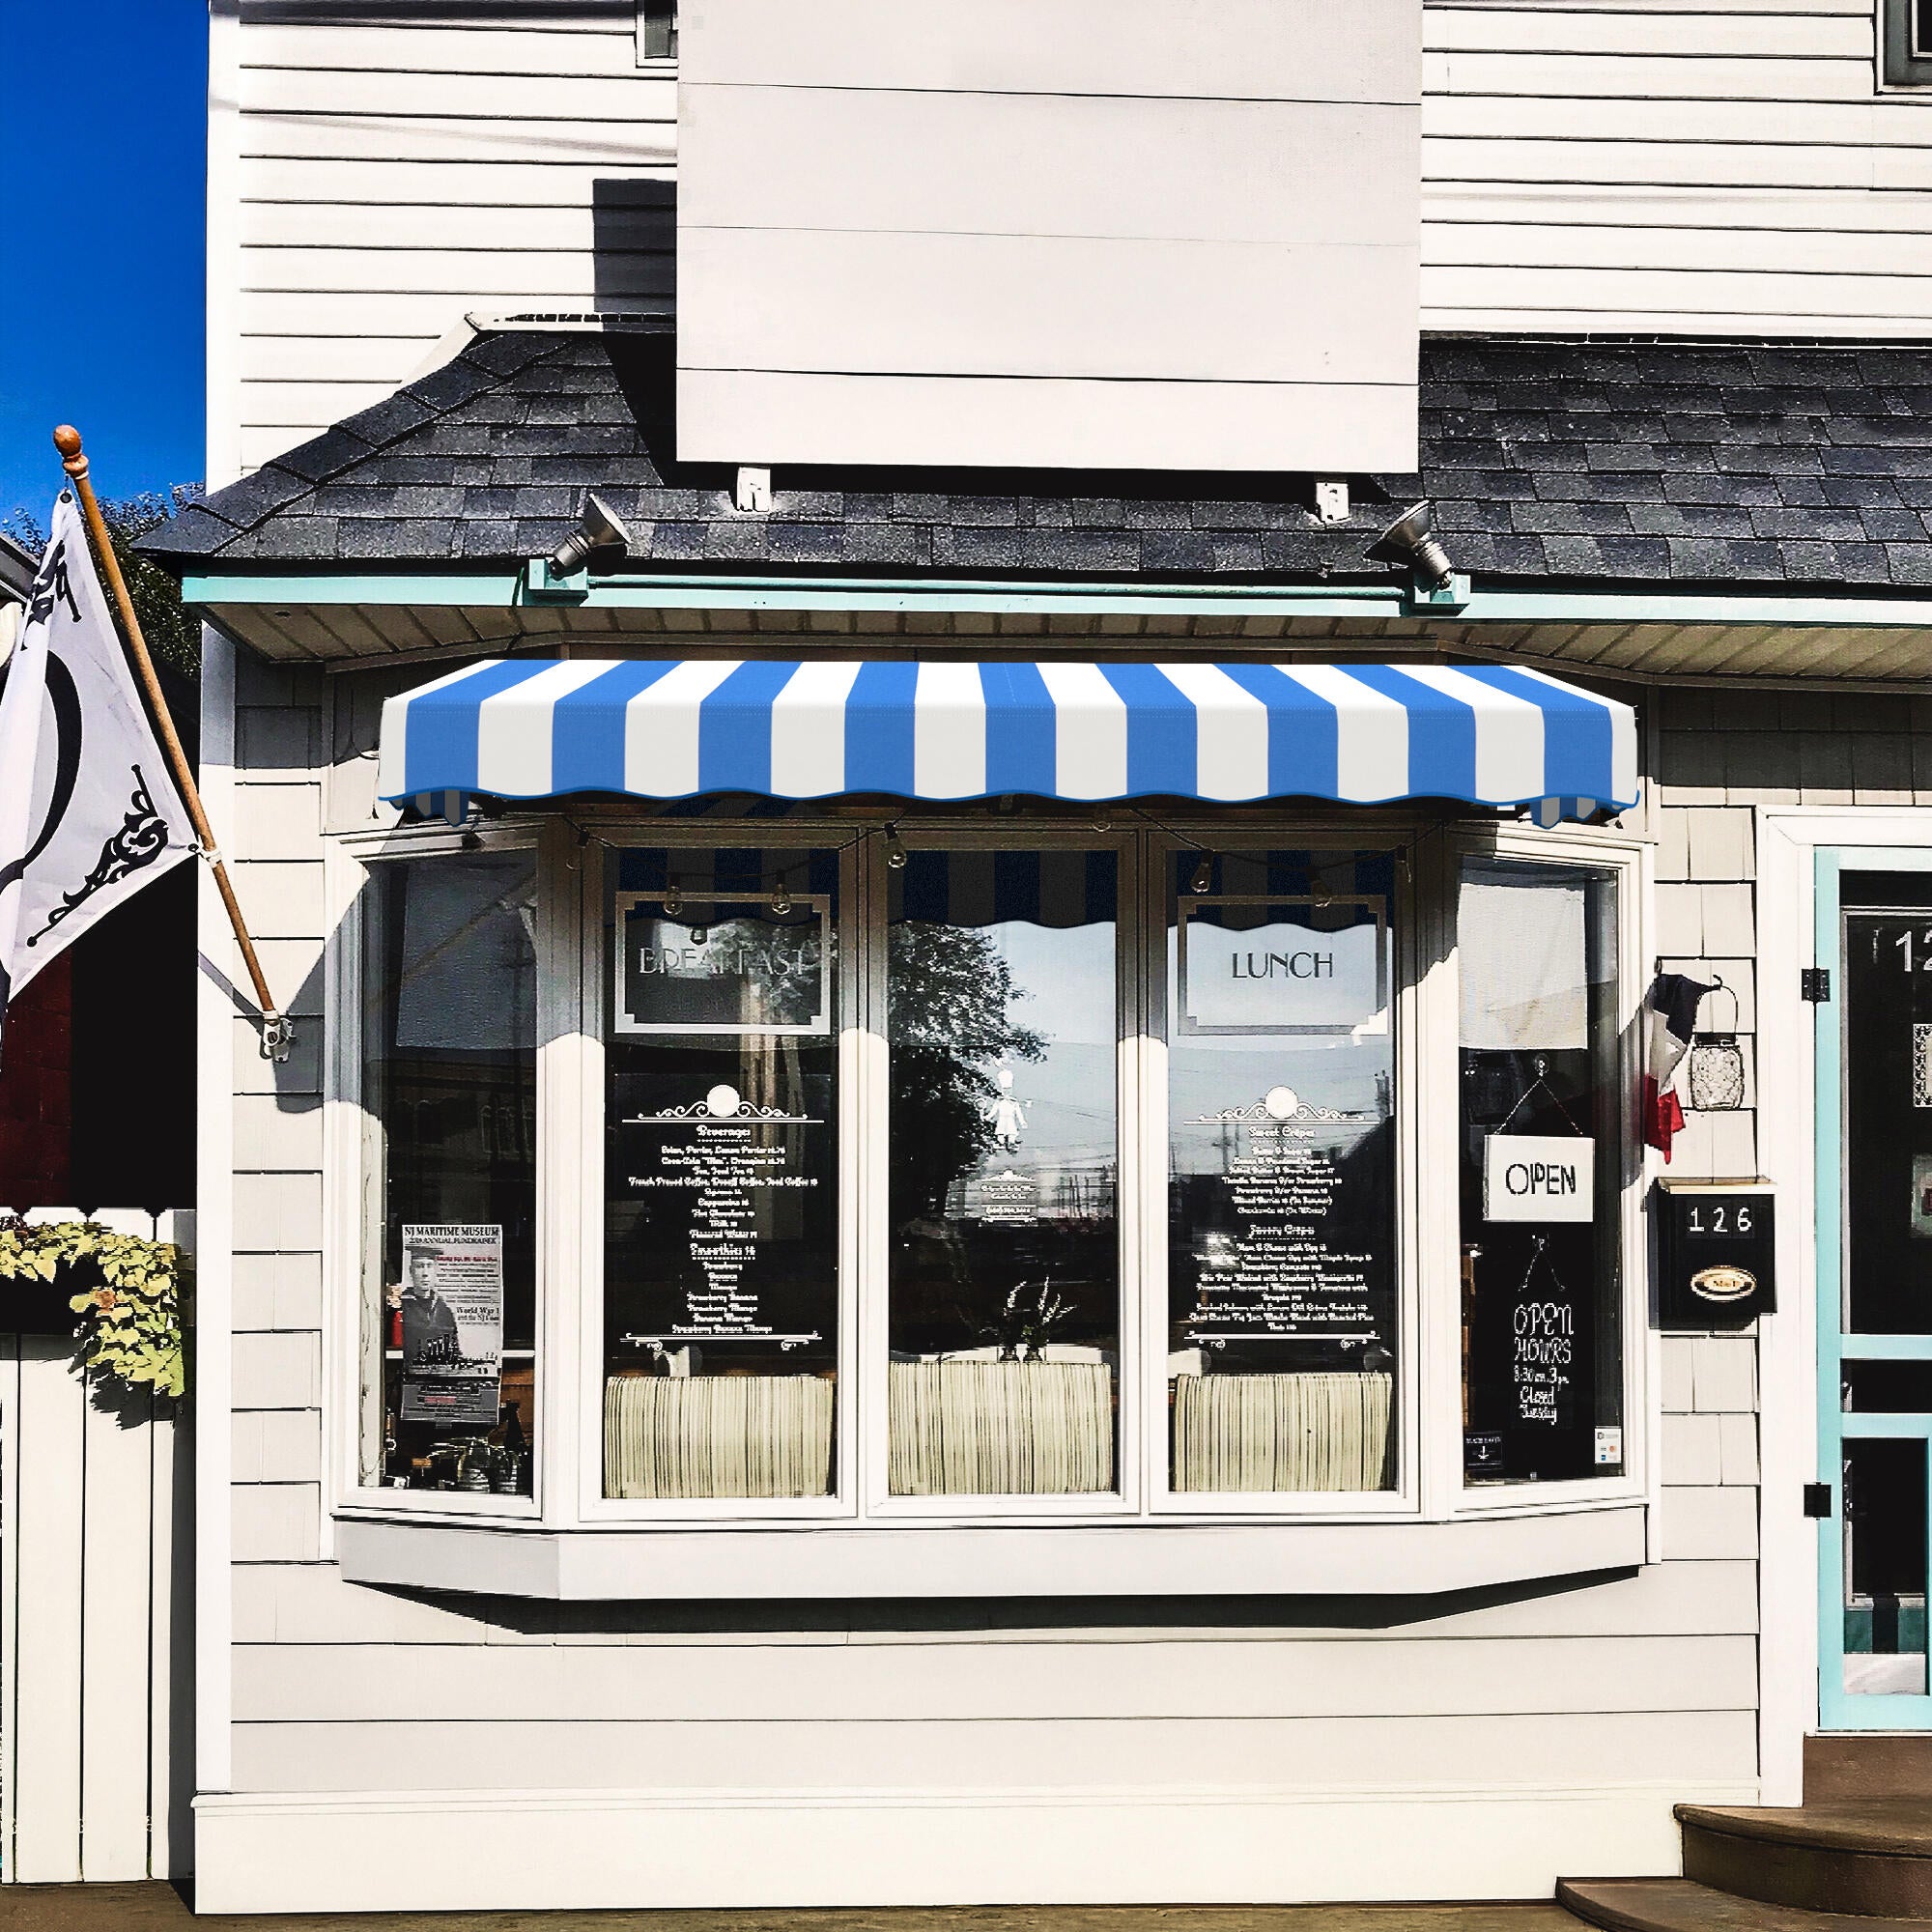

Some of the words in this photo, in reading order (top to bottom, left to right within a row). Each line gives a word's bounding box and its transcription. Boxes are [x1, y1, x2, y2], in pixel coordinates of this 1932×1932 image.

[1233, 952, 1333, 979] LUNCH
[1248, 1126, 1279, 1137] Sweet
[1505, 1163, 1576, 1196] OPEN
[416, 1227, 461, 1236] MARITIME
[461, 1227, 499, 1236] MUSEUM
[1690, 1207, 1751, 1232] 126
[1514, 1303, 1574, 1335] OPEN
[1515, 1337, 1571, 1363] HOURS
